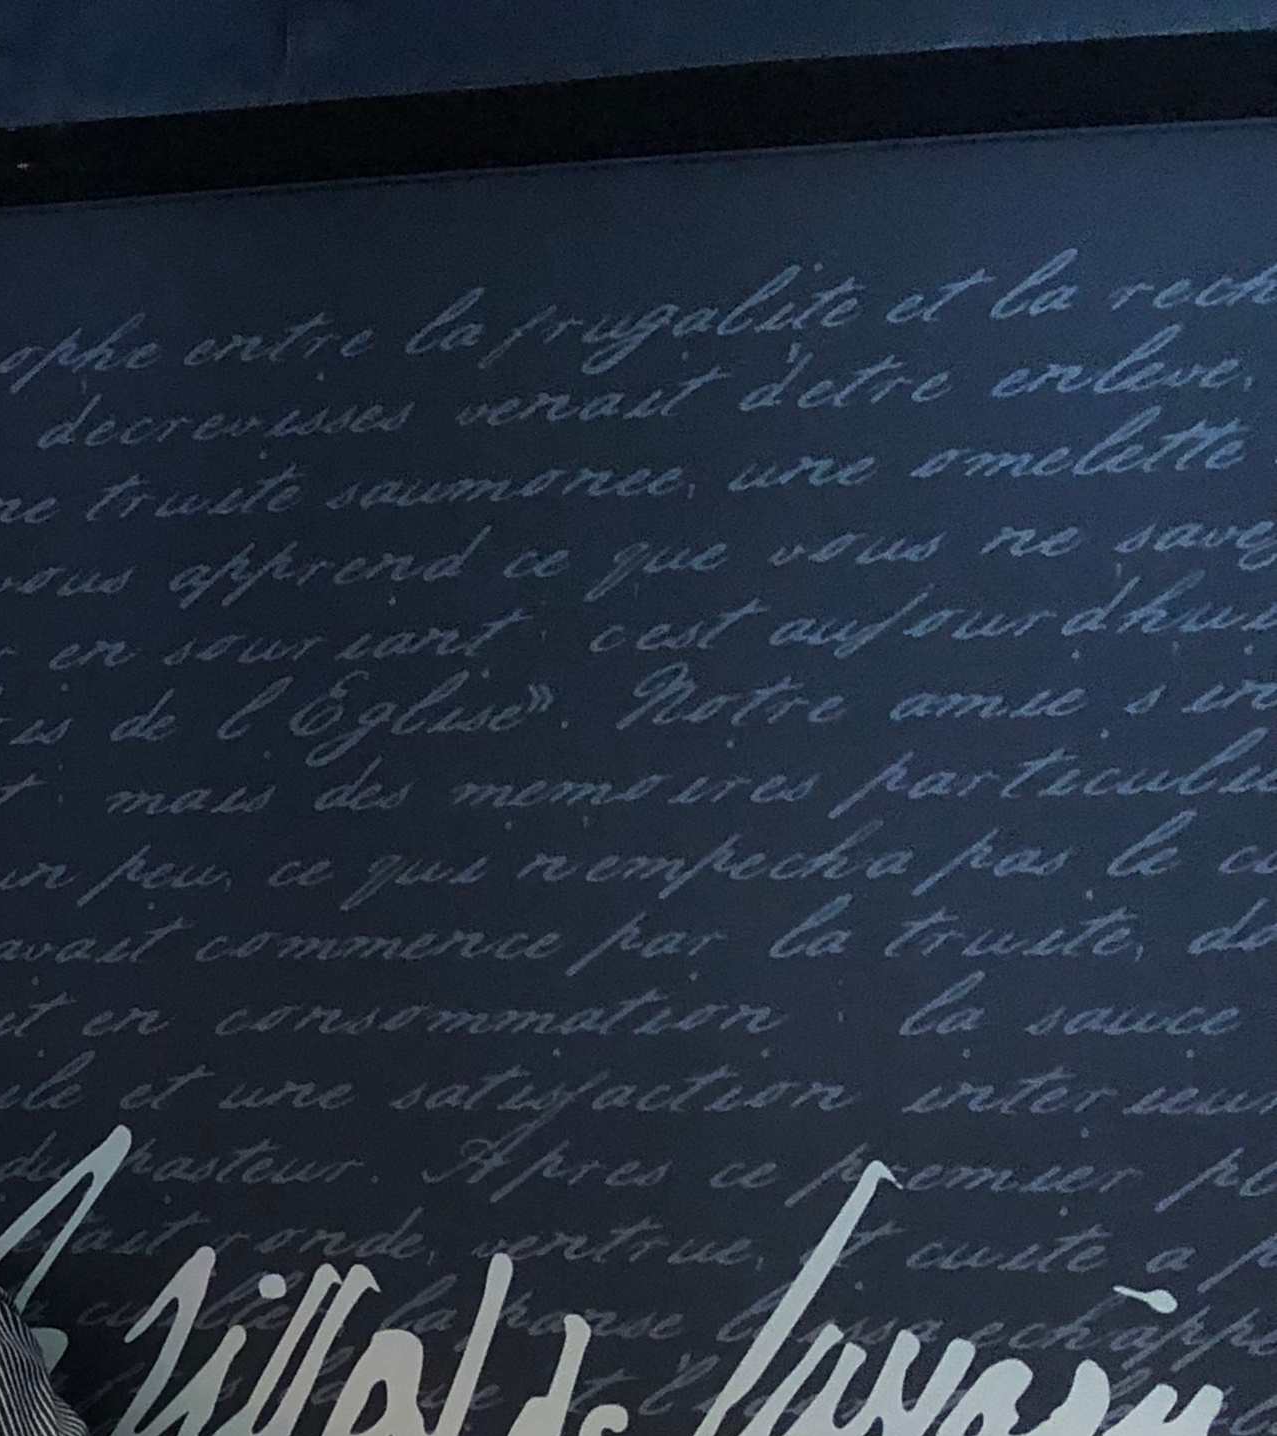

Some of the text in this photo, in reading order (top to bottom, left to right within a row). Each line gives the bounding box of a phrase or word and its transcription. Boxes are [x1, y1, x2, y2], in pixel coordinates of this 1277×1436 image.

[184, 311, 374, 368] entre
[405, 286, 485, 354] la
[886, 268, 996, 323] et
[989, 247, 1078, 319] la
[910, 404, 1251, 478] omelette
[169, 524, 492, 609] apprend
[503, 550, 570, 578] ce
[768, 531, 946, 565] vous
[110, 687, 177, 743] de
[314, 756, 414, 811] des
[769, 893, 853, 959] la
[899, 970, 987, 1038] la
